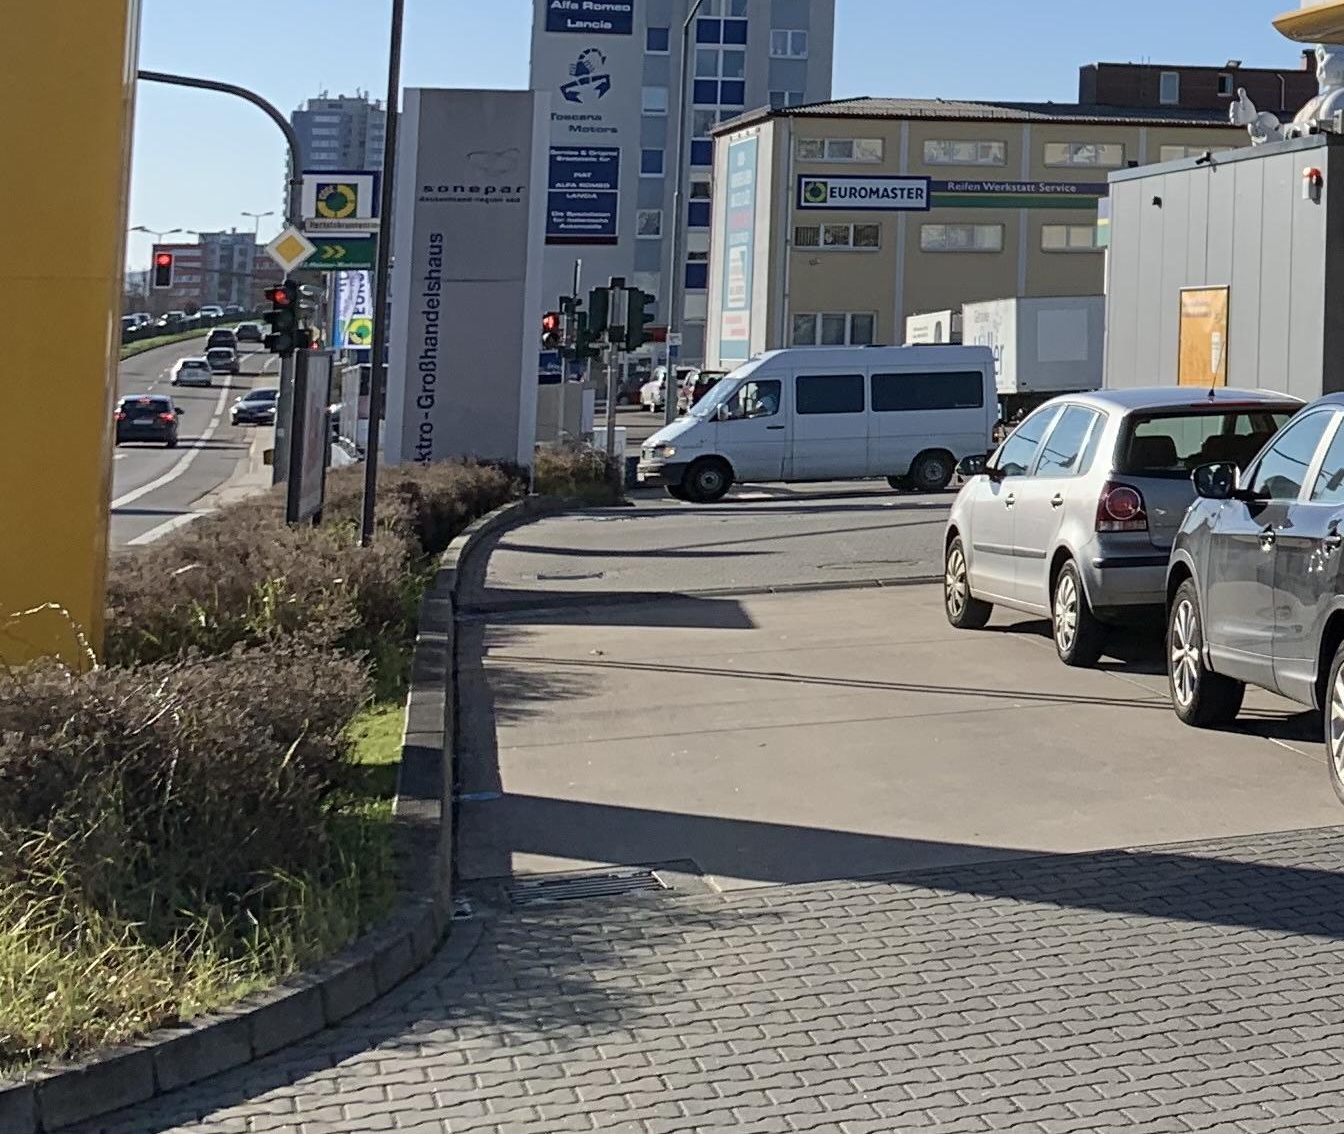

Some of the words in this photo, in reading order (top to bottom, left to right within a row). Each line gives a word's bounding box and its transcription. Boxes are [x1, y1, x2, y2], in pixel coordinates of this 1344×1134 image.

[550, 0, 579, 10] Alfa
[582, 1, 631, 12] Romeo
[566, 18, 613, 30] Lancia
[568, 124, 618, 135] Motors
[423, 185, 526, 196] sonepar
[829, 184, 925, 200] EUROMASTER
[947, 181, 981, 192] Reifen
[983, 181, 1036, 193] Werkstatt
[1038, 182, 1077, 194] Service
[413, 232, 445, 465] ktro-Großhandelshaus
